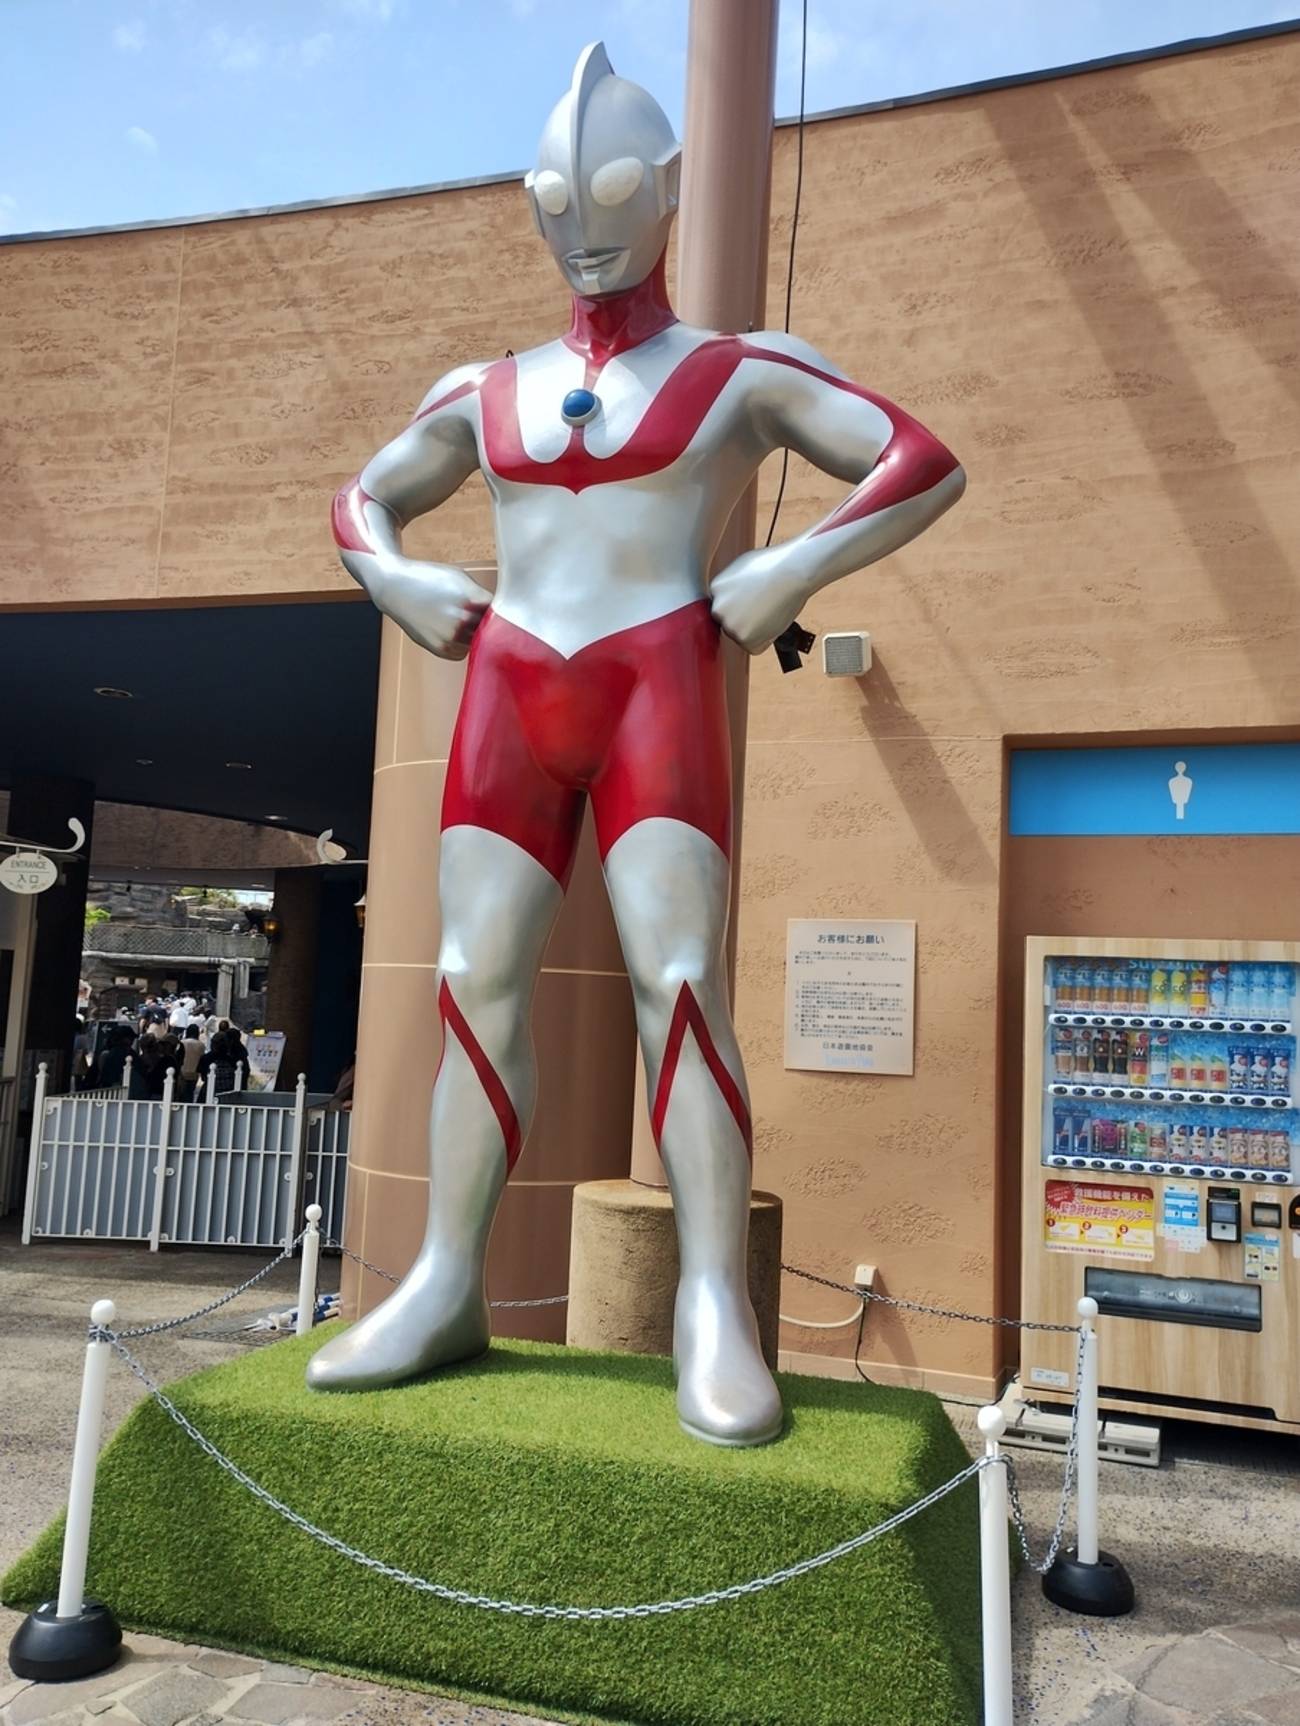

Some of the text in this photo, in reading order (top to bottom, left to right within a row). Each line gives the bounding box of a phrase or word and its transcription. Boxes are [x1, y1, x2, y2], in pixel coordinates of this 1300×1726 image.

[11, 860, 46, 869] ENTRANCE
[17, 874, 39, 883] 入口
[817, 934, 885, 944] お客様にお願い
